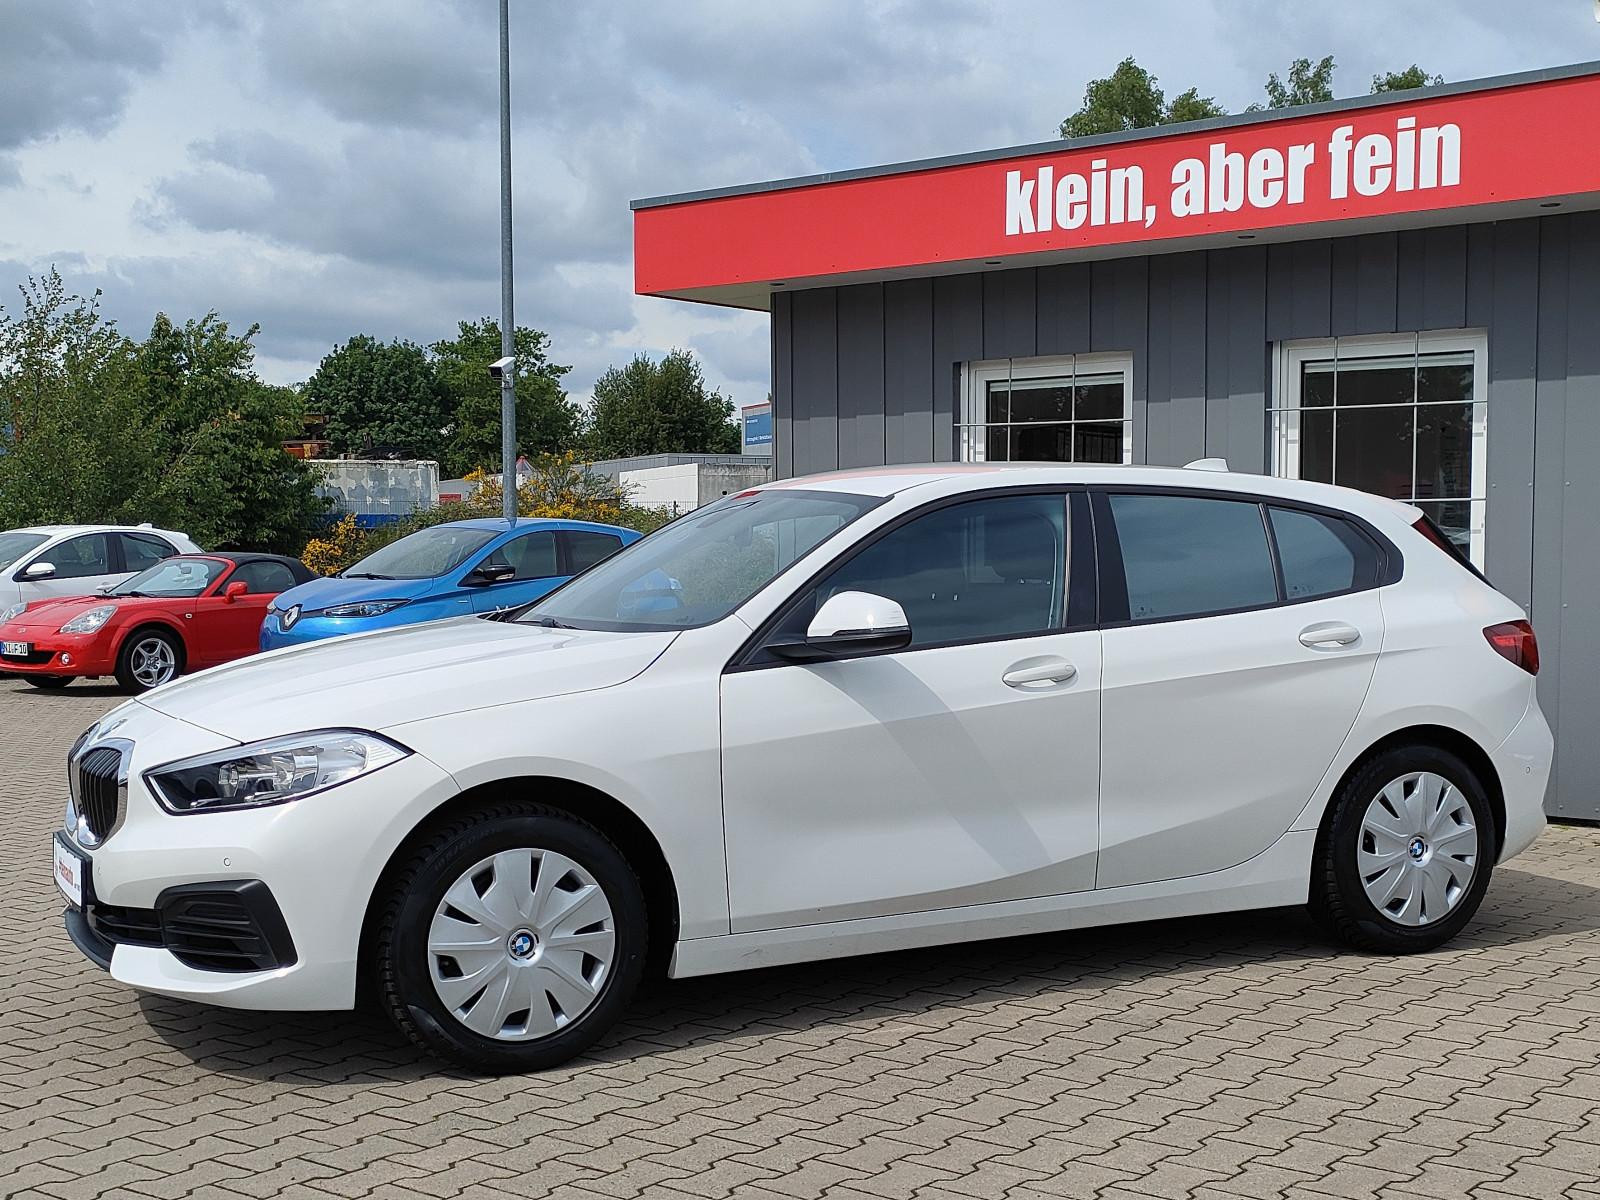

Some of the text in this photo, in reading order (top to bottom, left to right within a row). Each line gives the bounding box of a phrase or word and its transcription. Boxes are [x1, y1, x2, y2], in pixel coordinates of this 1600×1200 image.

[1005, 116, 1461, 236] klein, aber fein
[19, 644, 27, 655] 10
